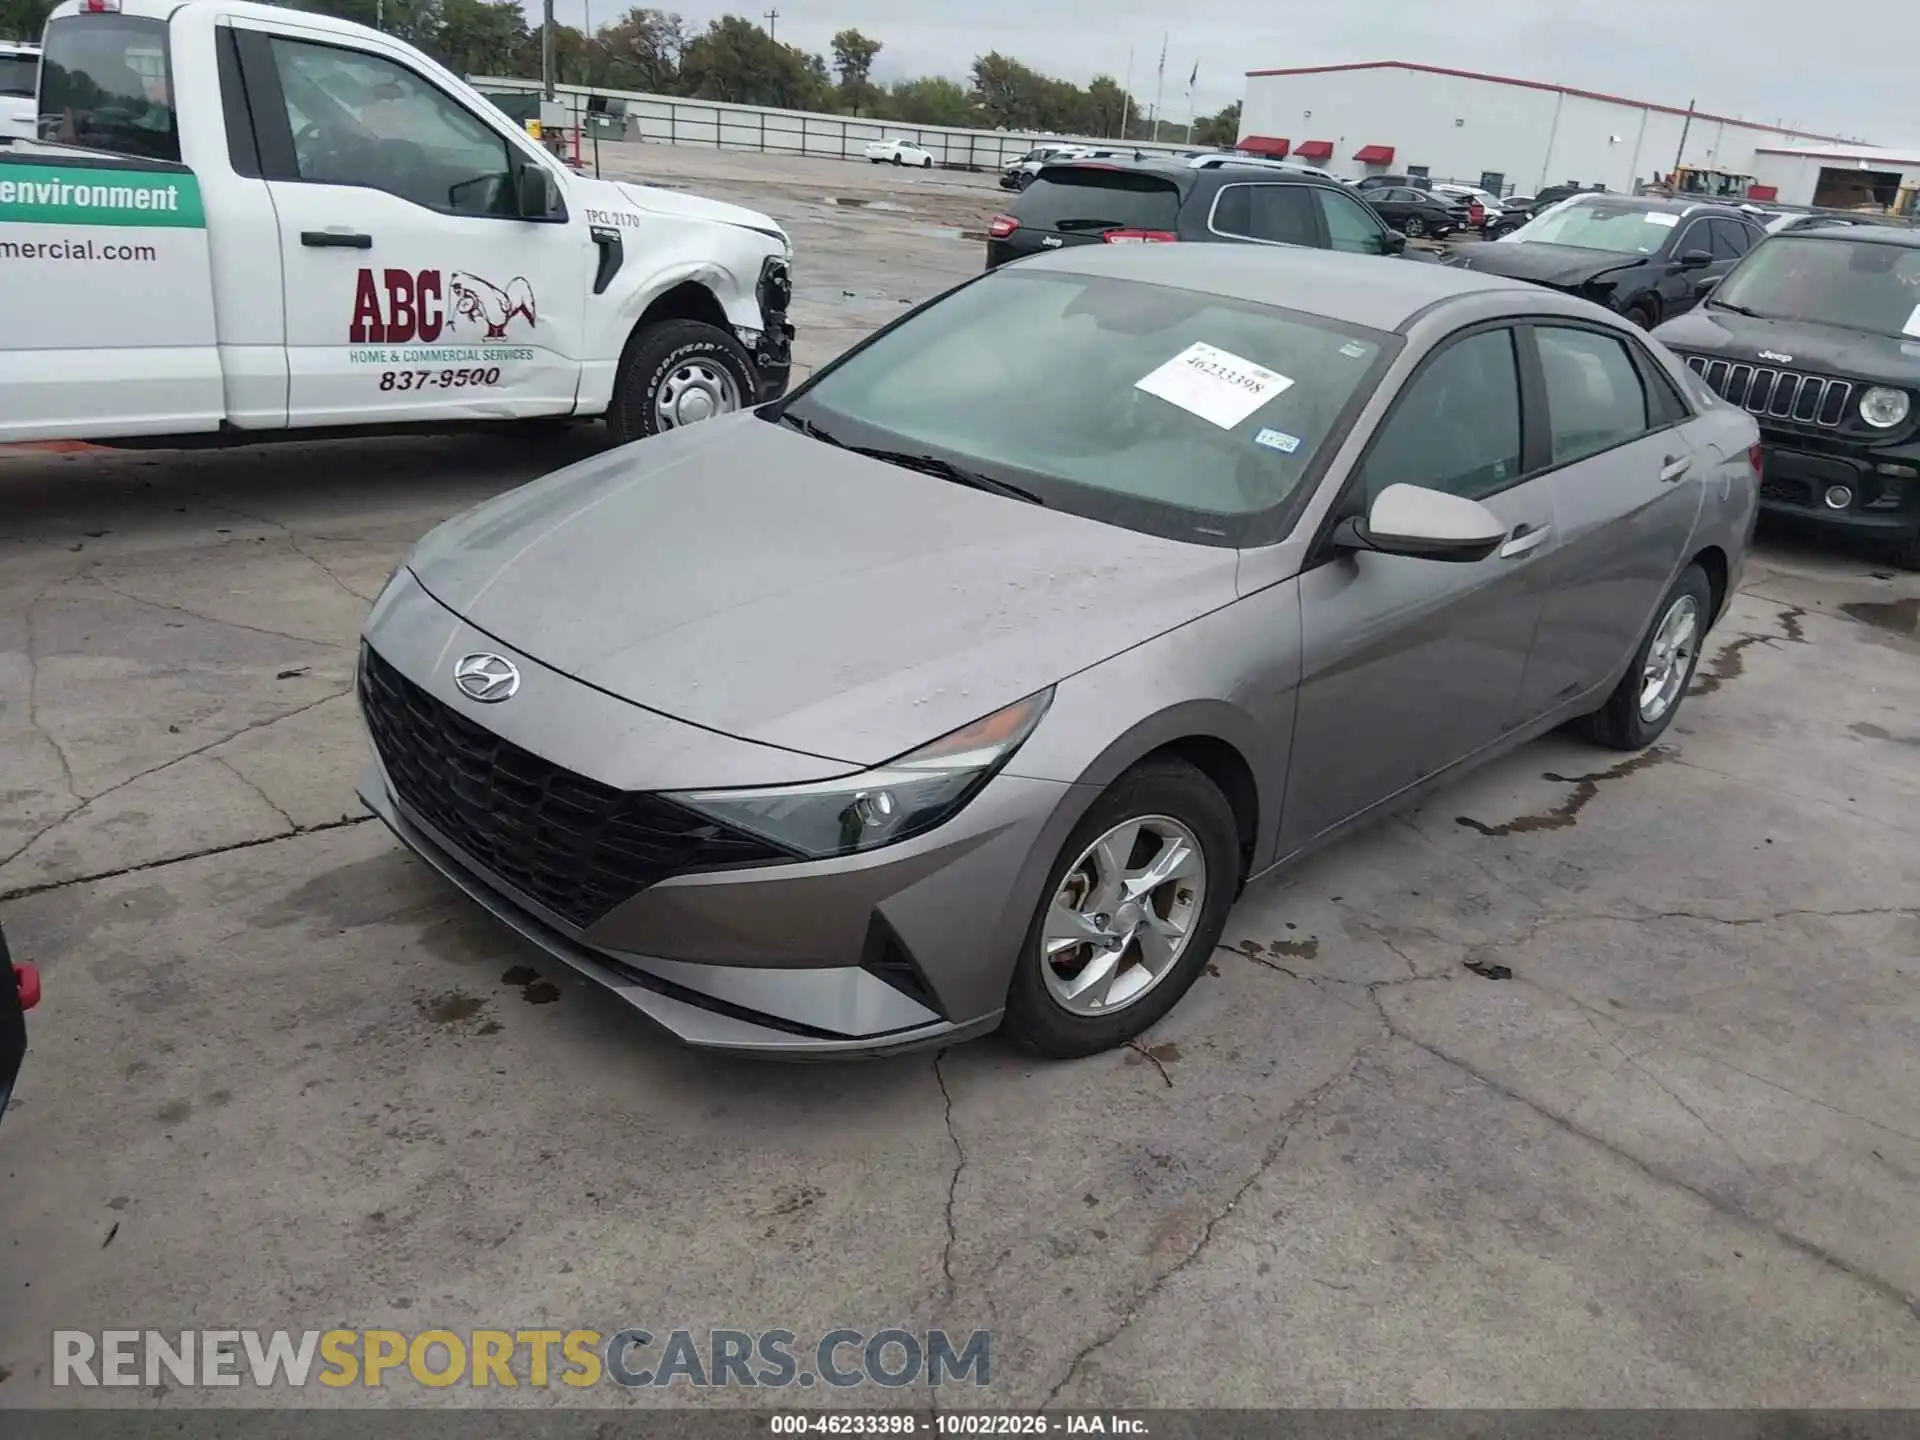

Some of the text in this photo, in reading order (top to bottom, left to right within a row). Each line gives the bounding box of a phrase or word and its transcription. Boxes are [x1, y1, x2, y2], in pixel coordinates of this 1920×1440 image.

[0, 177, 179, 211] environment
[612, 211, 640, 228] 2170
[0, 239, 157, 261] mercial.com
[349, 268, 443, 344] ABC
[350, 349, 534, 363] HOME & COMMERCIAL SERVICES
[379, 366, 501, 391] 837-9500
